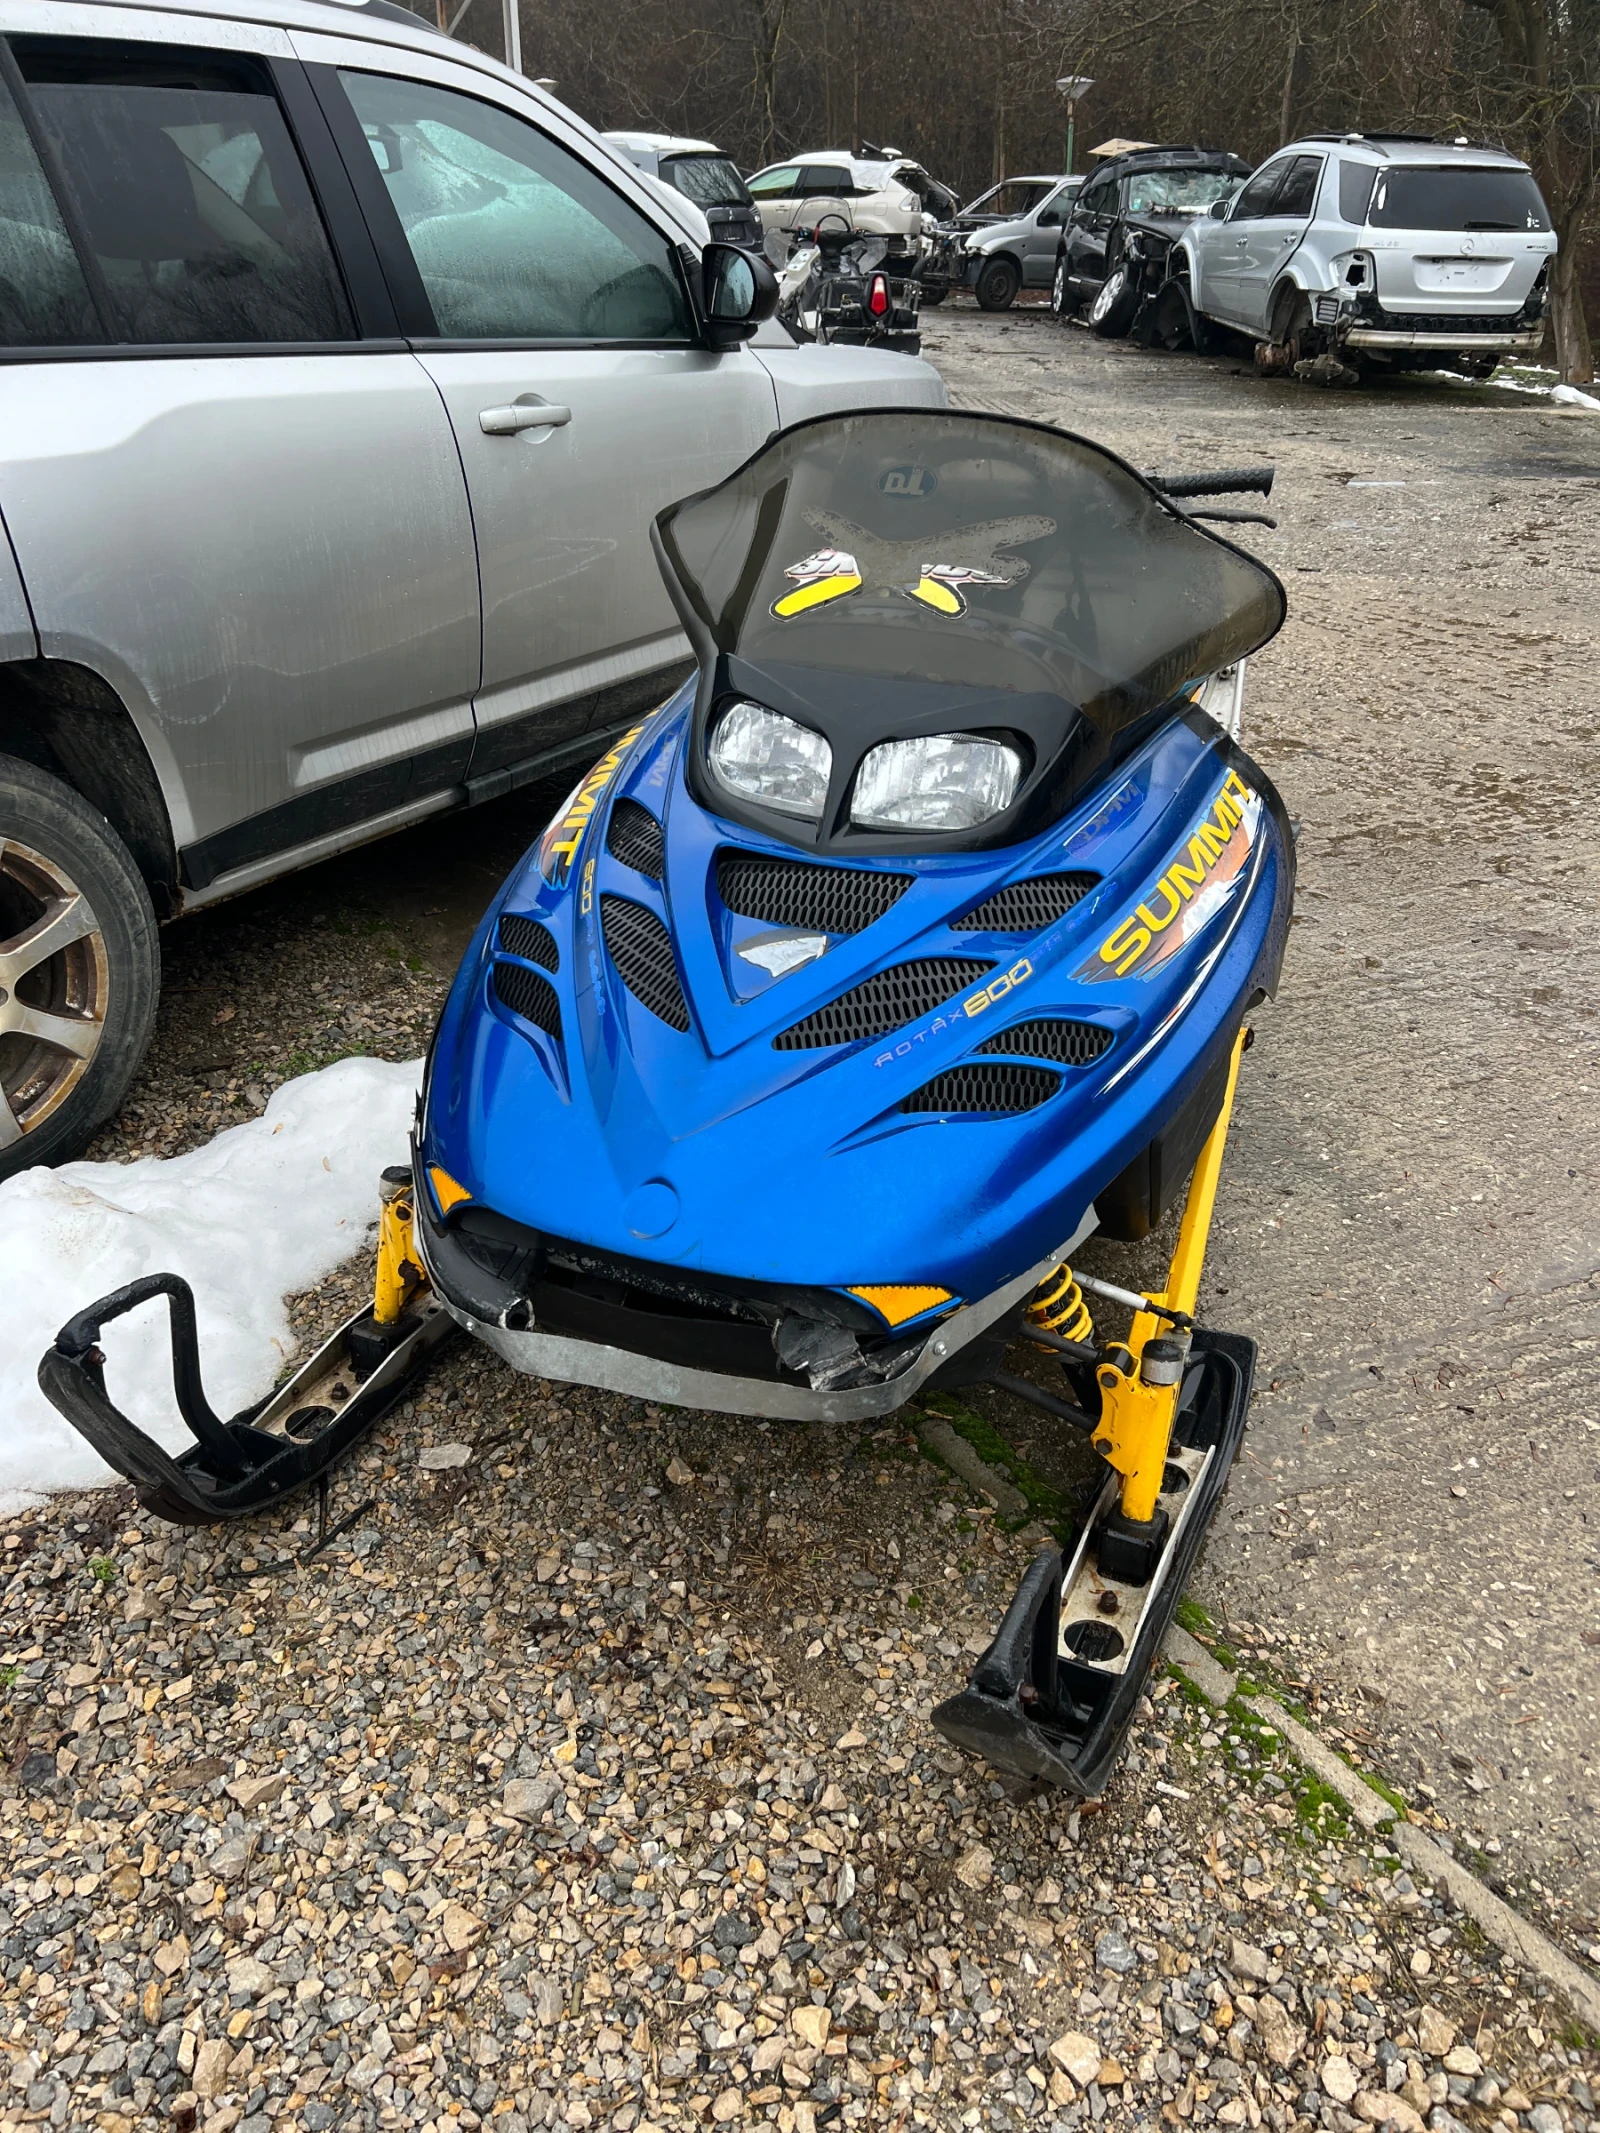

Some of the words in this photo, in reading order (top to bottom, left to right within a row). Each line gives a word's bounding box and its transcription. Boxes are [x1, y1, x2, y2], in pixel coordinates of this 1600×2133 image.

[1099, 770, 1251, 977] SUMMIT
[875, 1008, 963, 1067] ROTAX
[962, 957, 1035, 1018] 600
